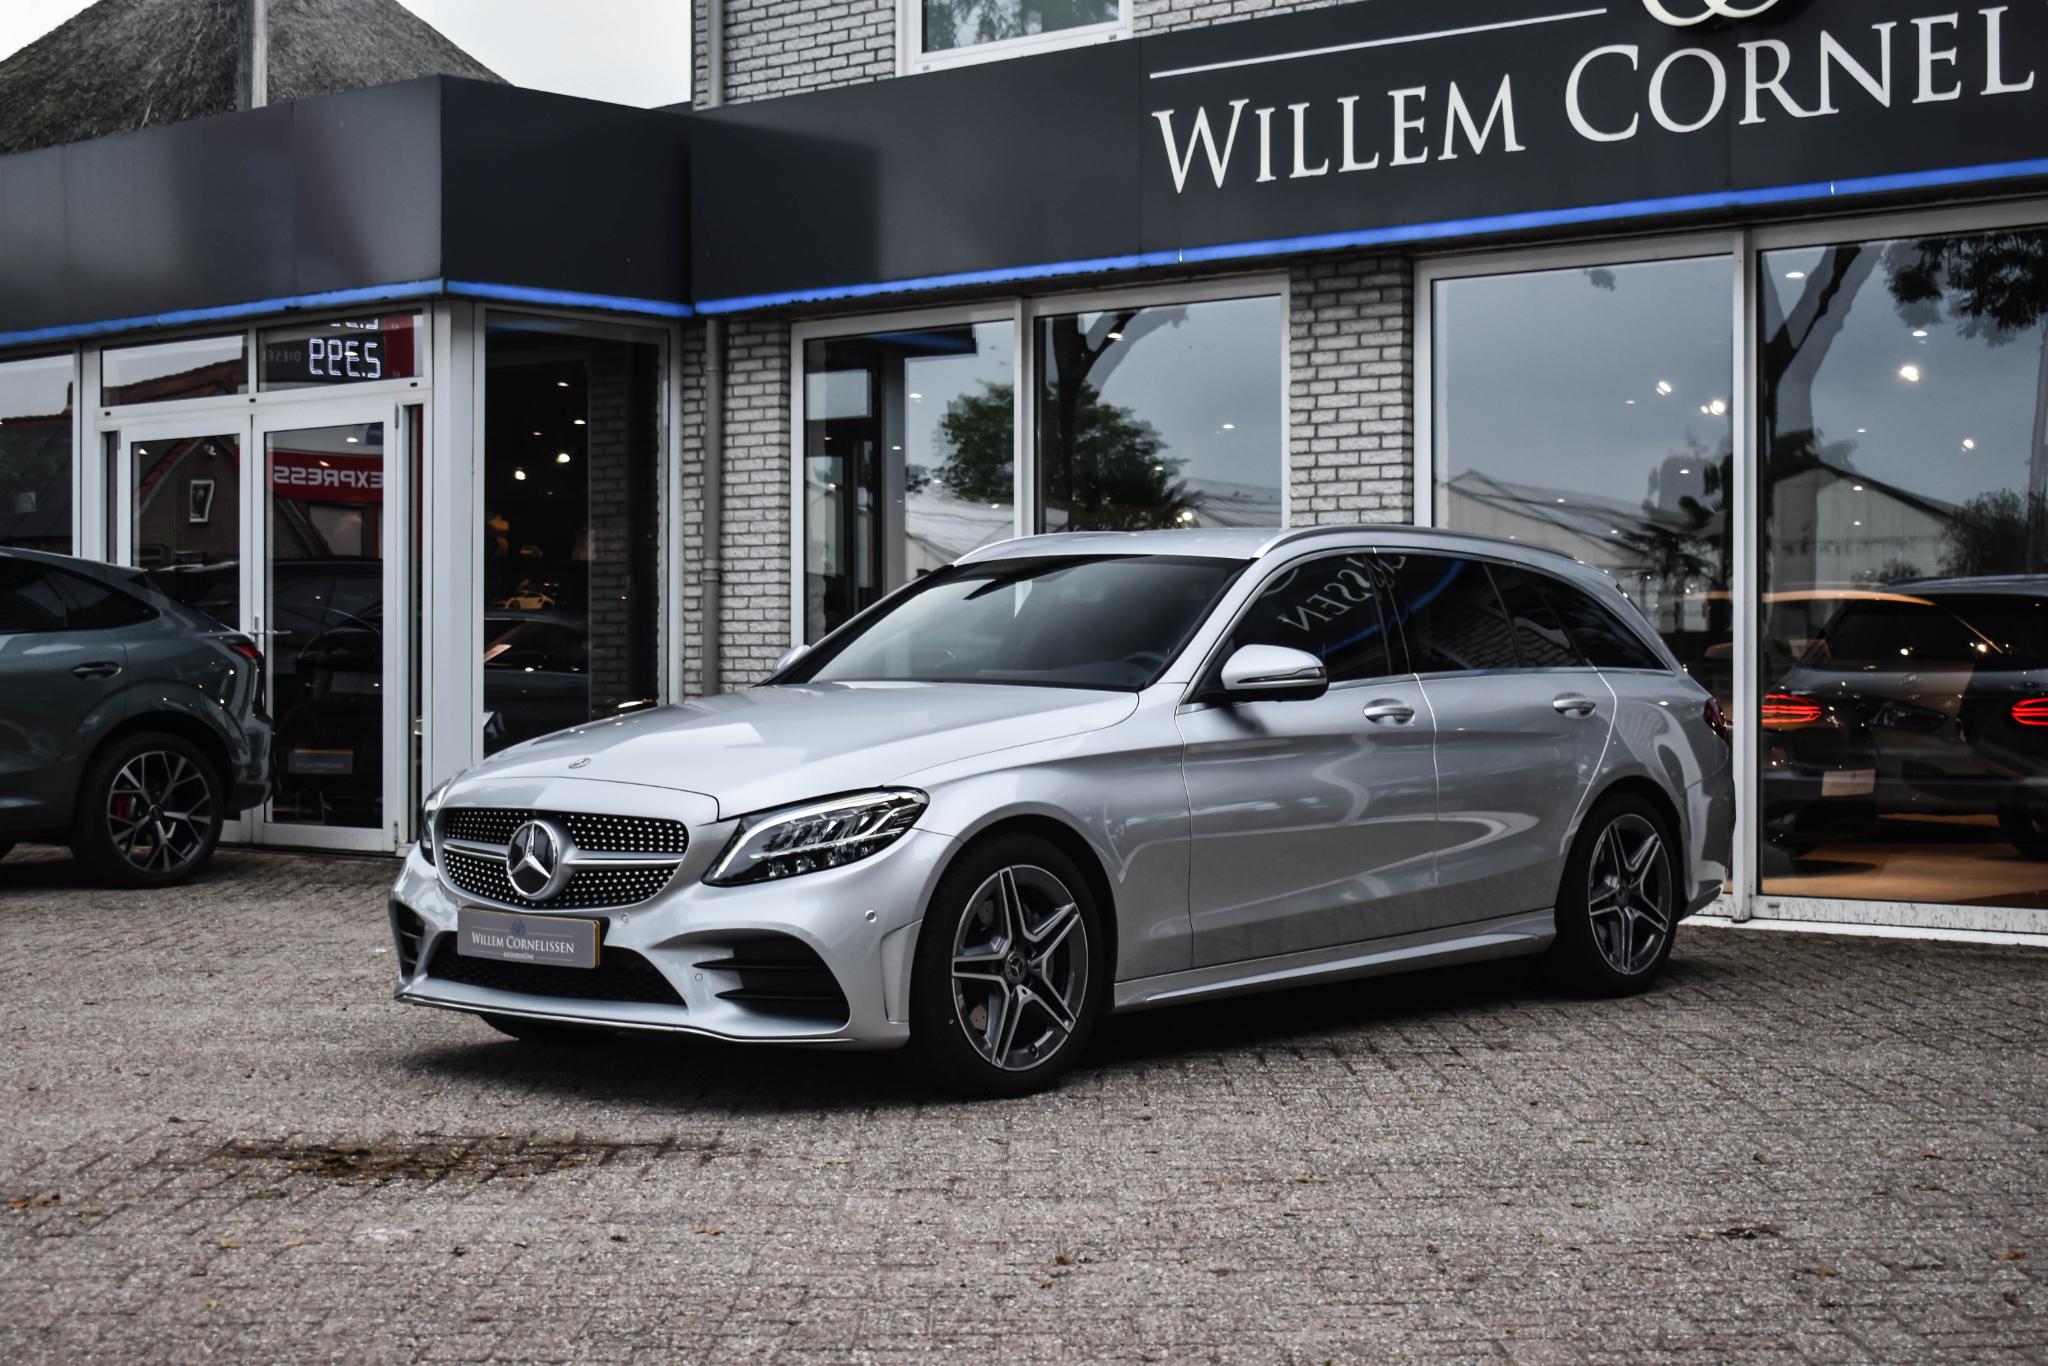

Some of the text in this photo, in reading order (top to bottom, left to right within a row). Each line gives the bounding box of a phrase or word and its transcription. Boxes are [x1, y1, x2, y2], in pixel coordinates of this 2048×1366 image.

[1151, 6, 2035, 194] WILLEM CORNEL
[471, 931, 575, 954] WILLEM CORNELISSEN
